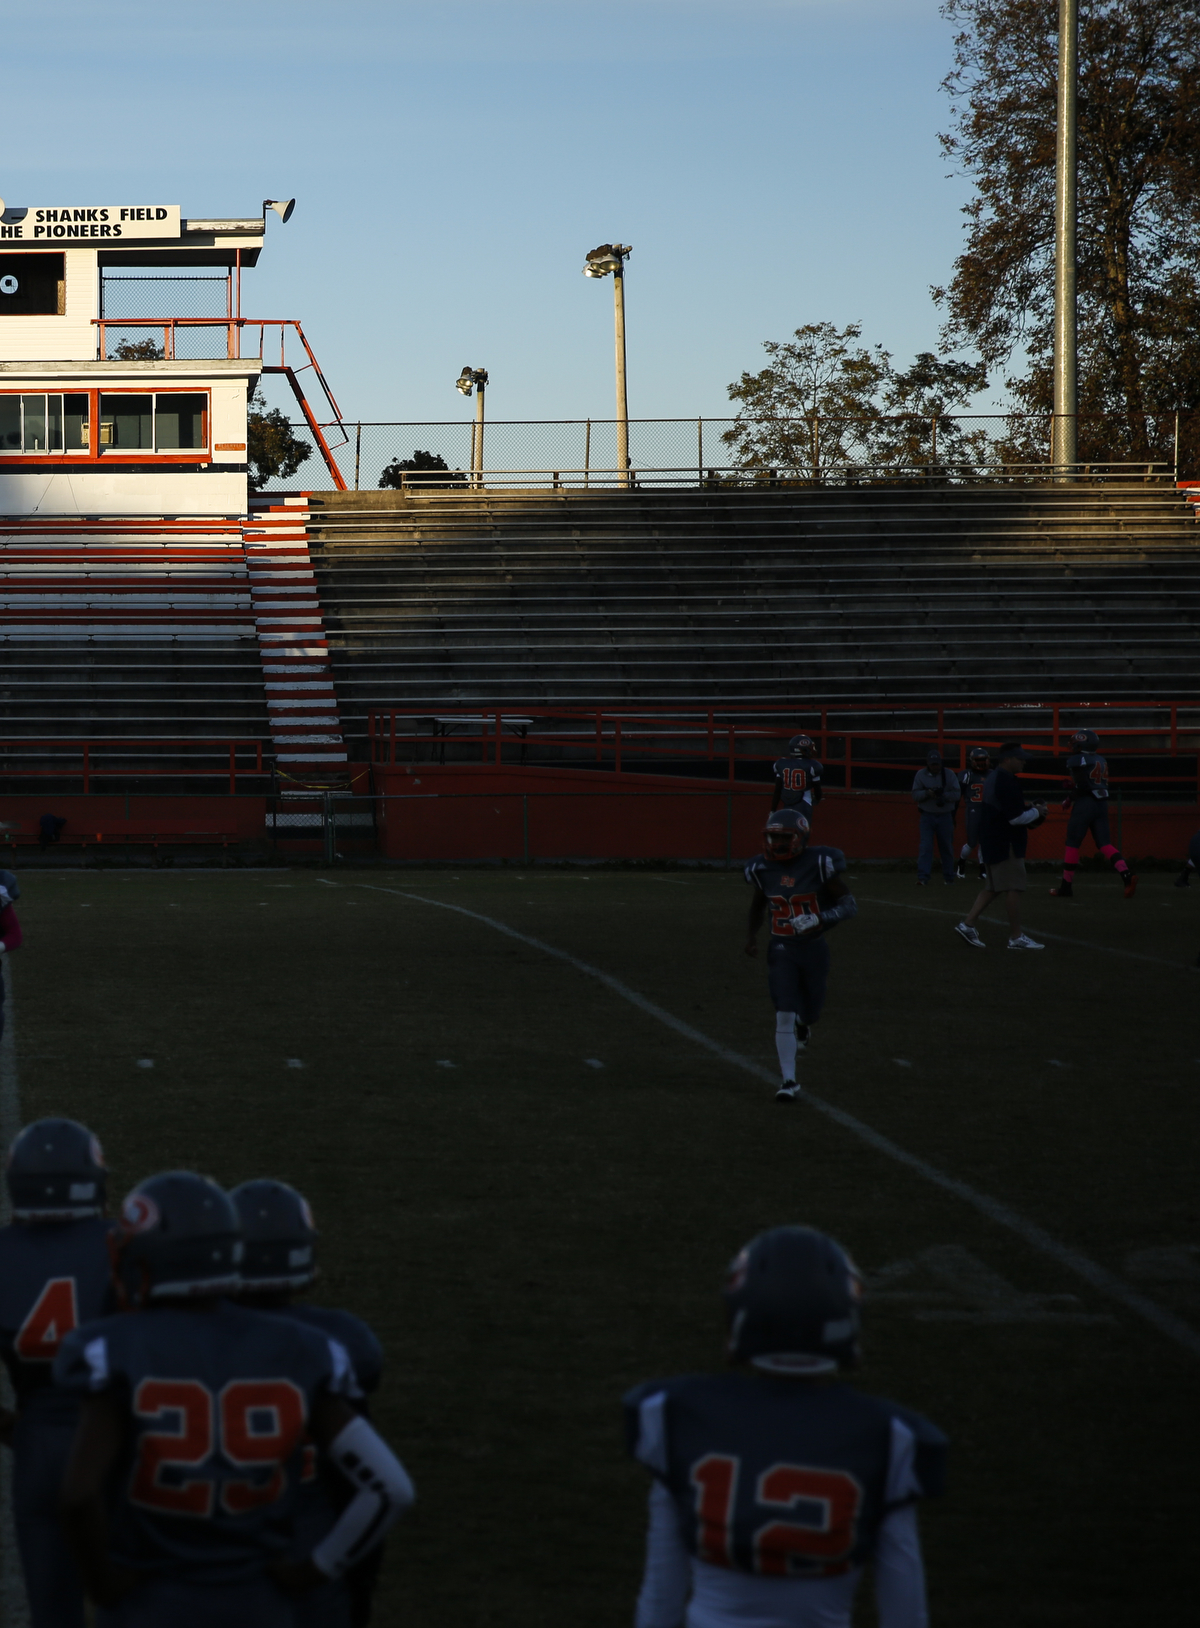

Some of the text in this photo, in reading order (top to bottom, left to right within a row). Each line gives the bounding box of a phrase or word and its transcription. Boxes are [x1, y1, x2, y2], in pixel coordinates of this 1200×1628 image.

[34, 223, 122, 238] PIONEERS
[35, 208, 109, 222] SHANKS
[120, 207, 168, 221] FIELD
[782, 767, 806, 791] 10
[766, 892, 822, 937] 20
[14, 1275, 79, 1363] 4
[129, 1376, 310, 1519] 29
[689, 1451, 865, 1578] 12
